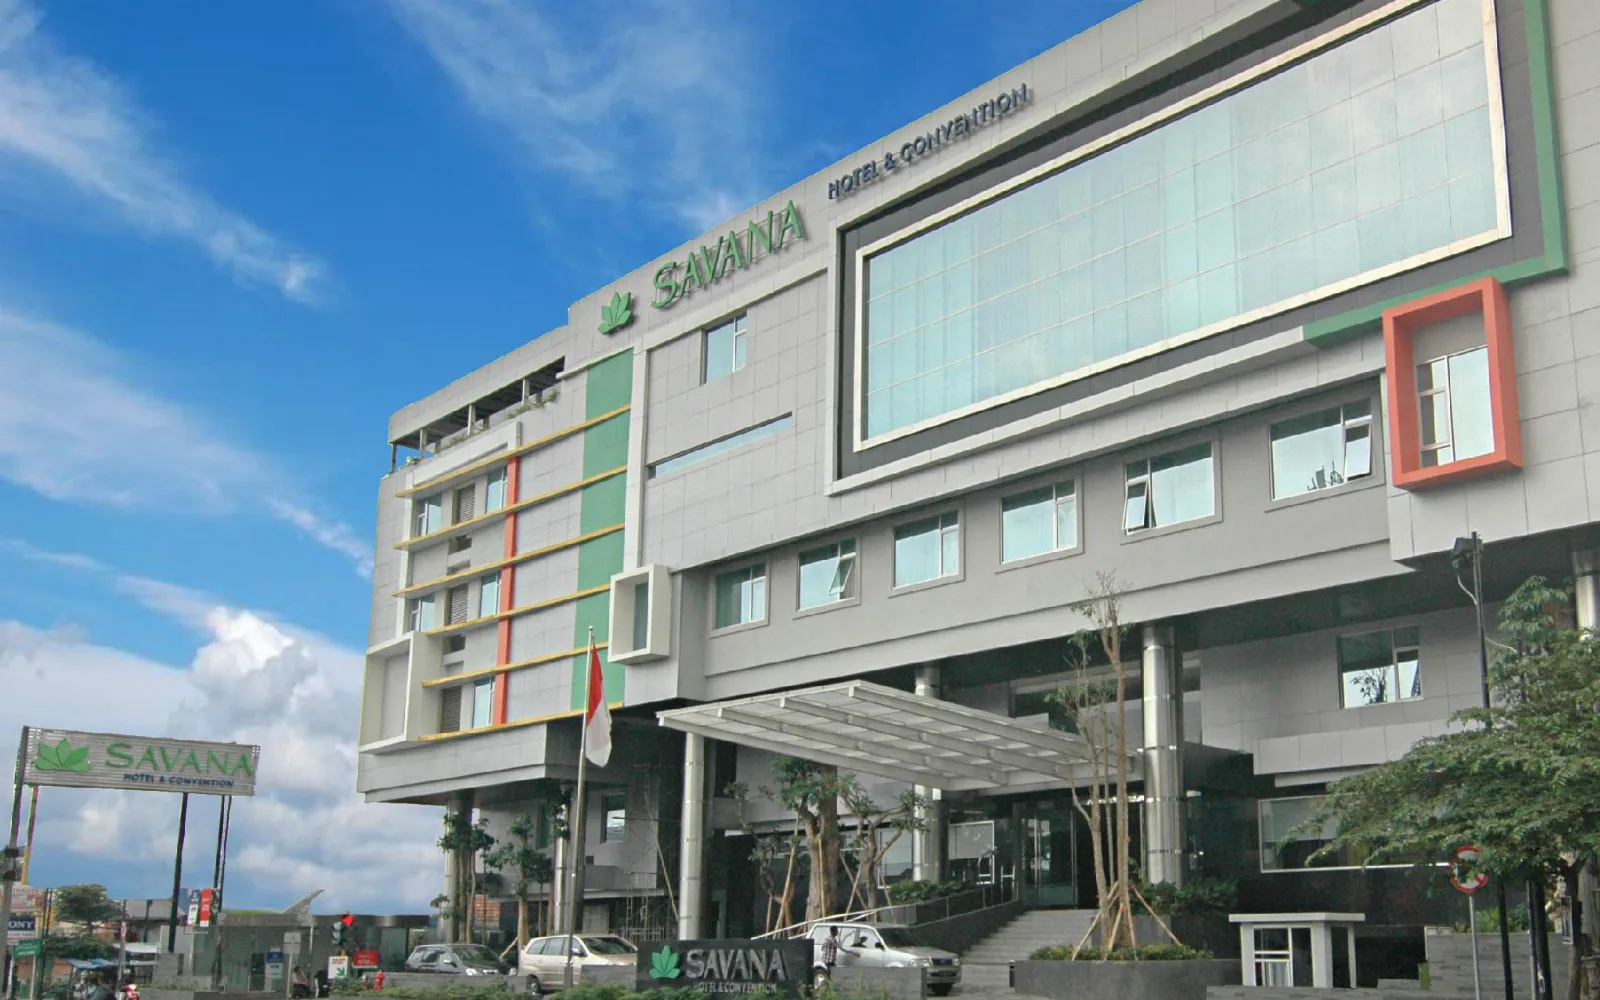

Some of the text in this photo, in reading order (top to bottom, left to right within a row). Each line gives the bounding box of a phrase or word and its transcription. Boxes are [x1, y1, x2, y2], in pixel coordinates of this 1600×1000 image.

[828, 83, 1027, 199] HOTEL & CONVENTION
[651, 200, 803, 309] SAVANA
[105, 741, 253, 777] SAVANA
[124, 772, 234, 788] HOTEL & CONVENTION
[8, 920, 34, 929] ONY
[685, 948, 786, 981] SAVANA
